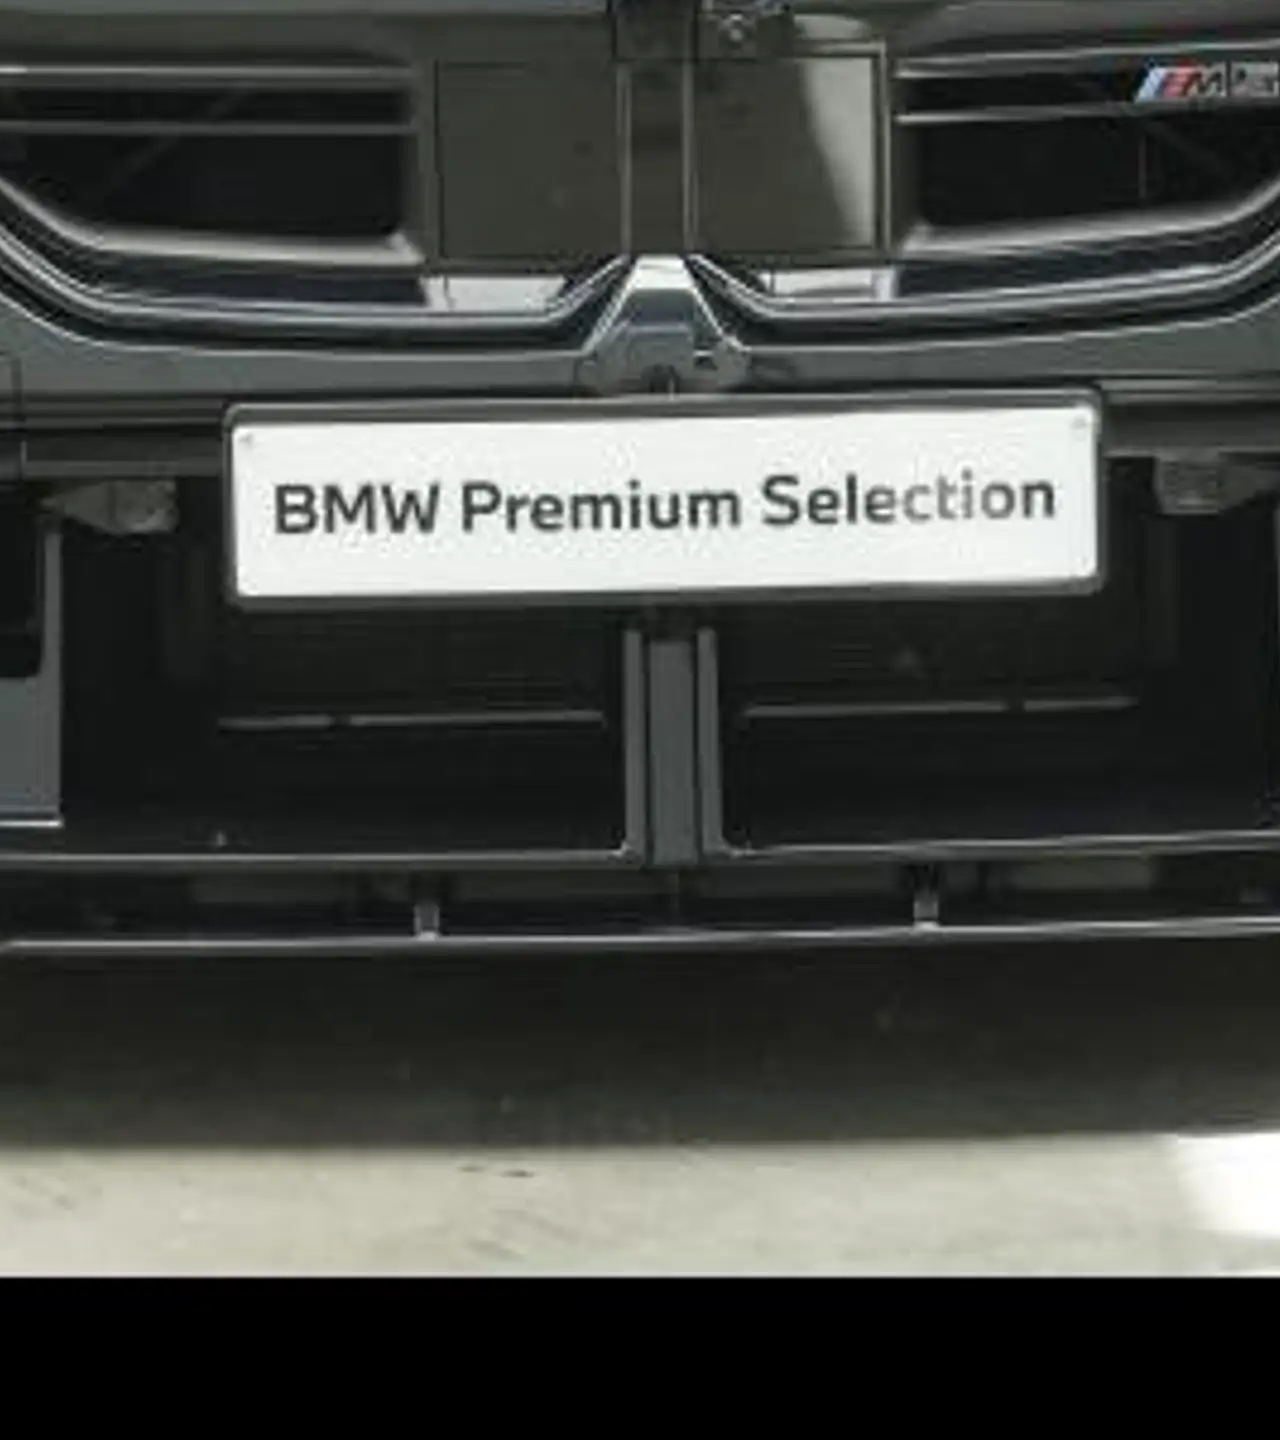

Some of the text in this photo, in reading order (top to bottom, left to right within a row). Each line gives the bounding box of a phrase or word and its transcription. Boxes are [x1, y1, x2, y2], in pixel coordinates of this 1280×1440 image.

[274, 469, 1055, 535] BMW Premium Selection
